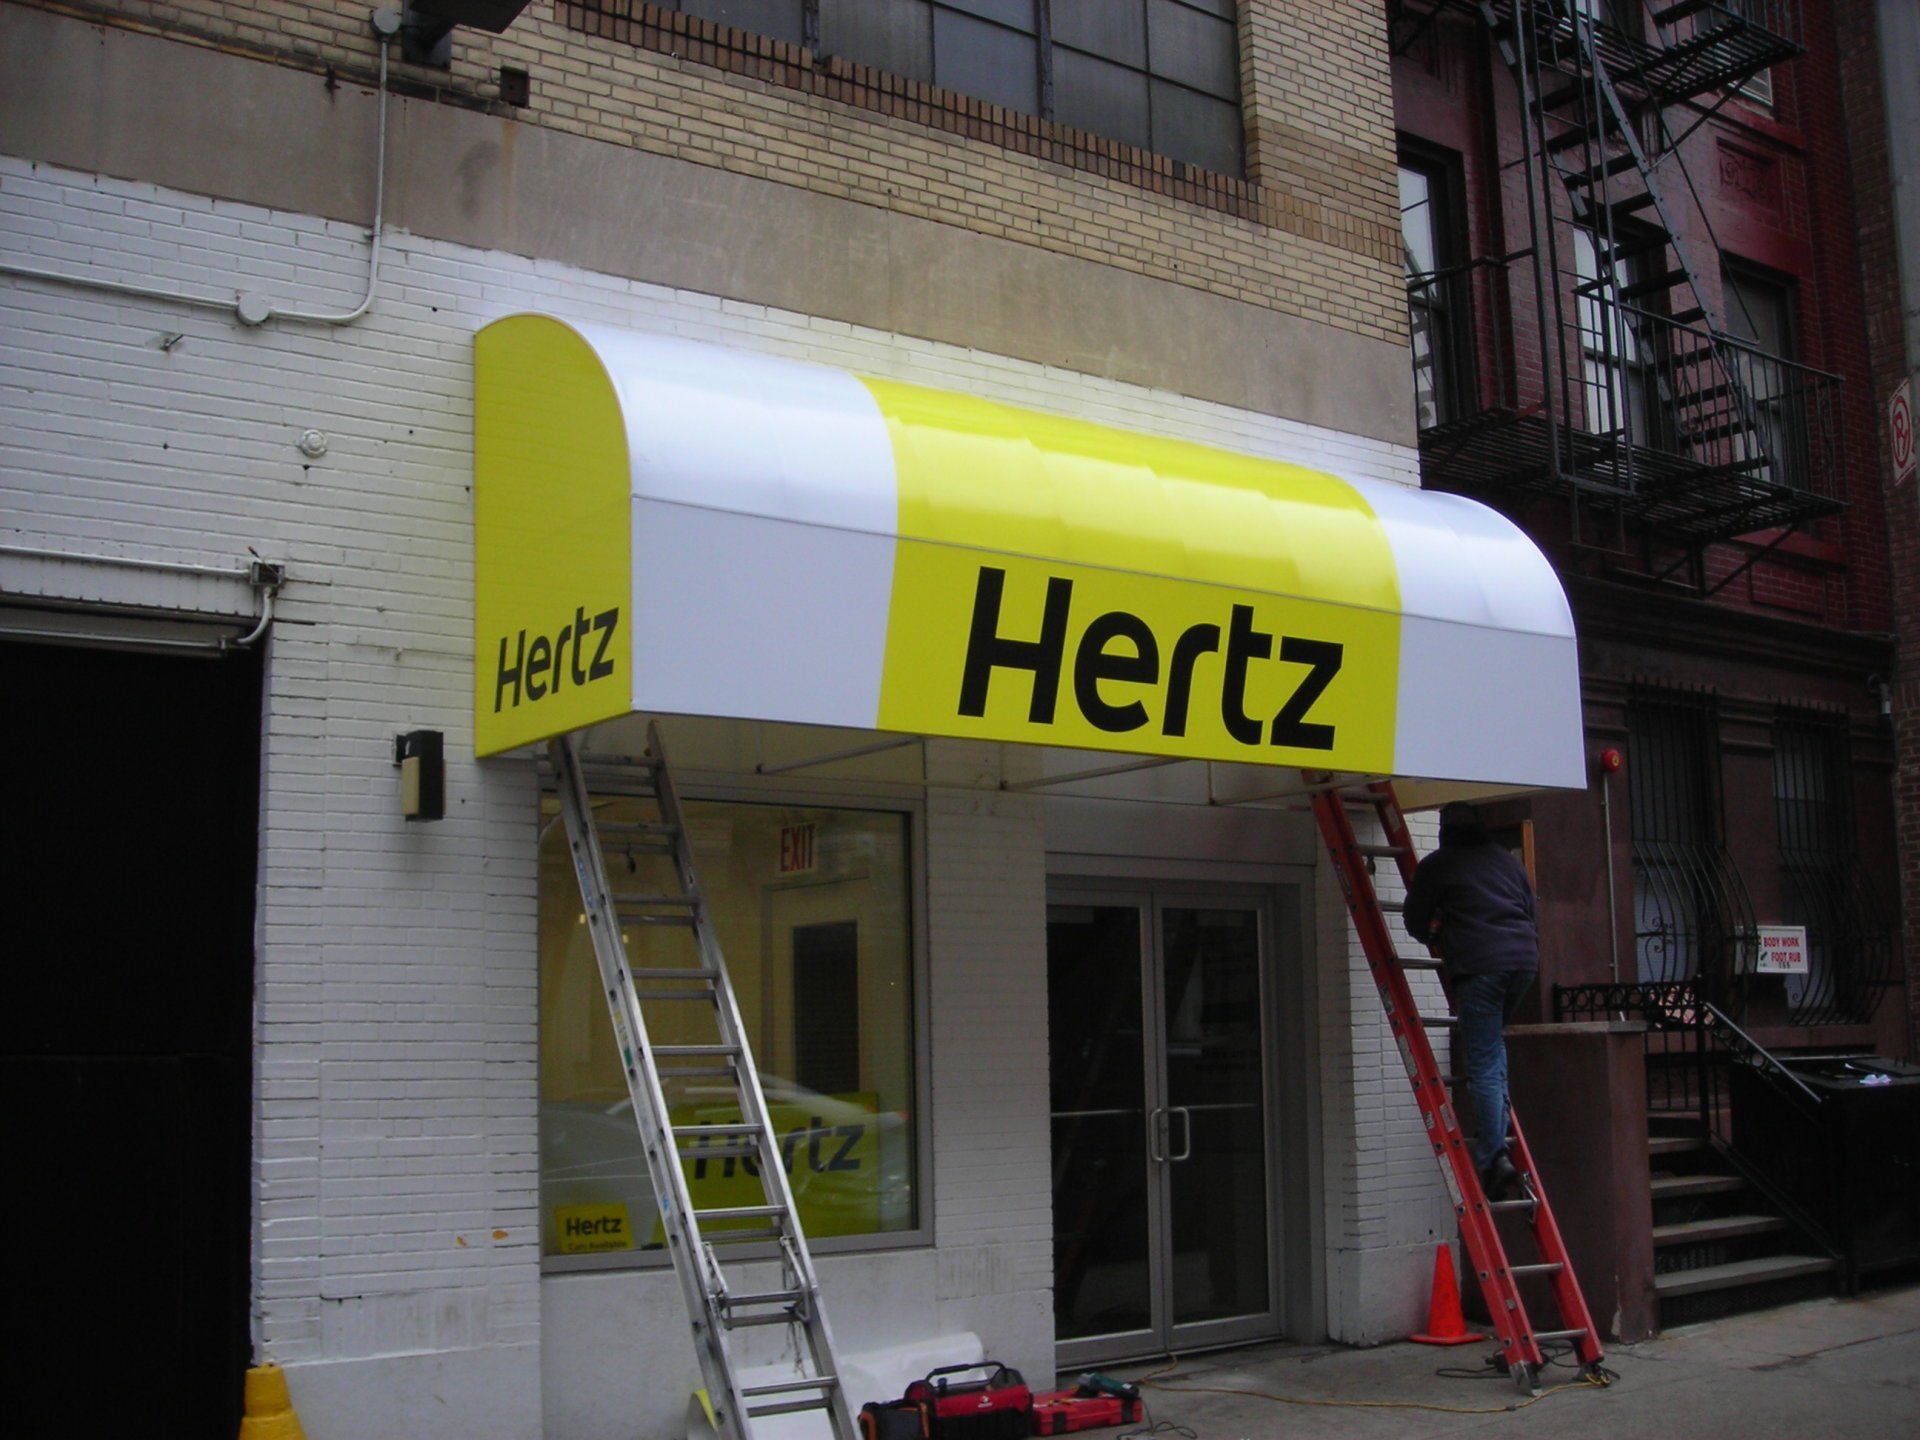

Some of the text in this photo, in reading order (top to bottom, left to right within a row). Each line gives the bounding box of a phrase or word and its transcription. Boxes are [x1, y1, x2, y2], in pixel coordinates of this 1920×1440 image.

[494, 606, 619, 713] Hertz
[958, 566, 1344, 751] Hertz
[780, 823, 816, 872] EXIT
[1763, 936, 1800, 947] BODY WORK
[1771, 951, 1787, 962] FOOT
[566, 1216, 622, 1236] Hertz
